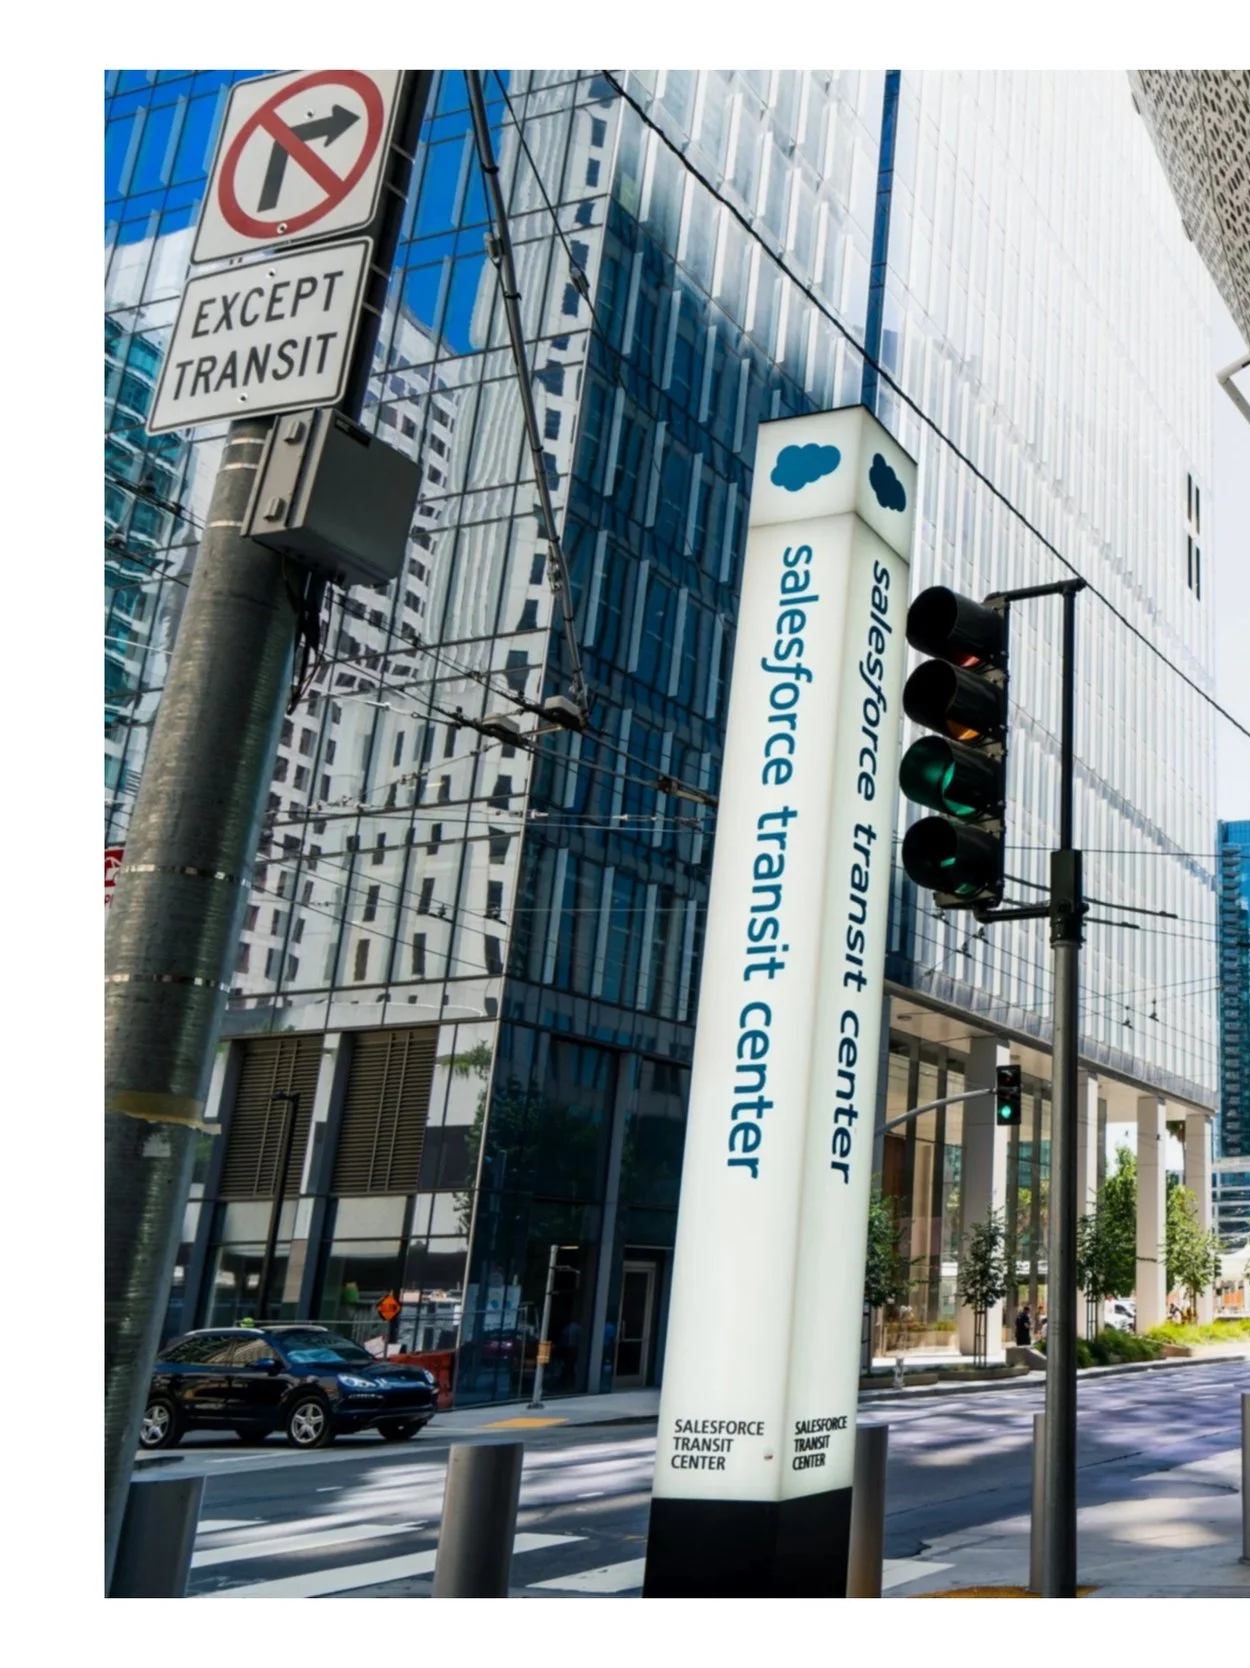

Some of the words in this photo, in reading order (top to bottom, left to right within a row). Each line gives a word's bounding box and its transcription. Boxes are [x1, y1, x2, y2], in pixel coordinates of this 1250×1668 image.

[191, 270, 344, 339] EXCEPT
[172, 332, 338, 401] TRANSIT
[761, 544, 820, 786] salesforce
[856, 560, 893, 802] salesforce
[742, 805, 798, 982] transit
[843, 822, 878, 993] transit
[726, 1000, 774, 1180] center
[830, 1009, 860, 1185] center
[673, 1436, 734, 1453] TRANSIT
[674, 1418, 765, 1436] SALESFORCE
[794, 1415, 848, 1436] SALESFORCE
[794, 1434, 831, 1453] TRANSIT
[671, 1454, 726, 1471] CENTER
[792, 1452, 826, 1471] CENTER
